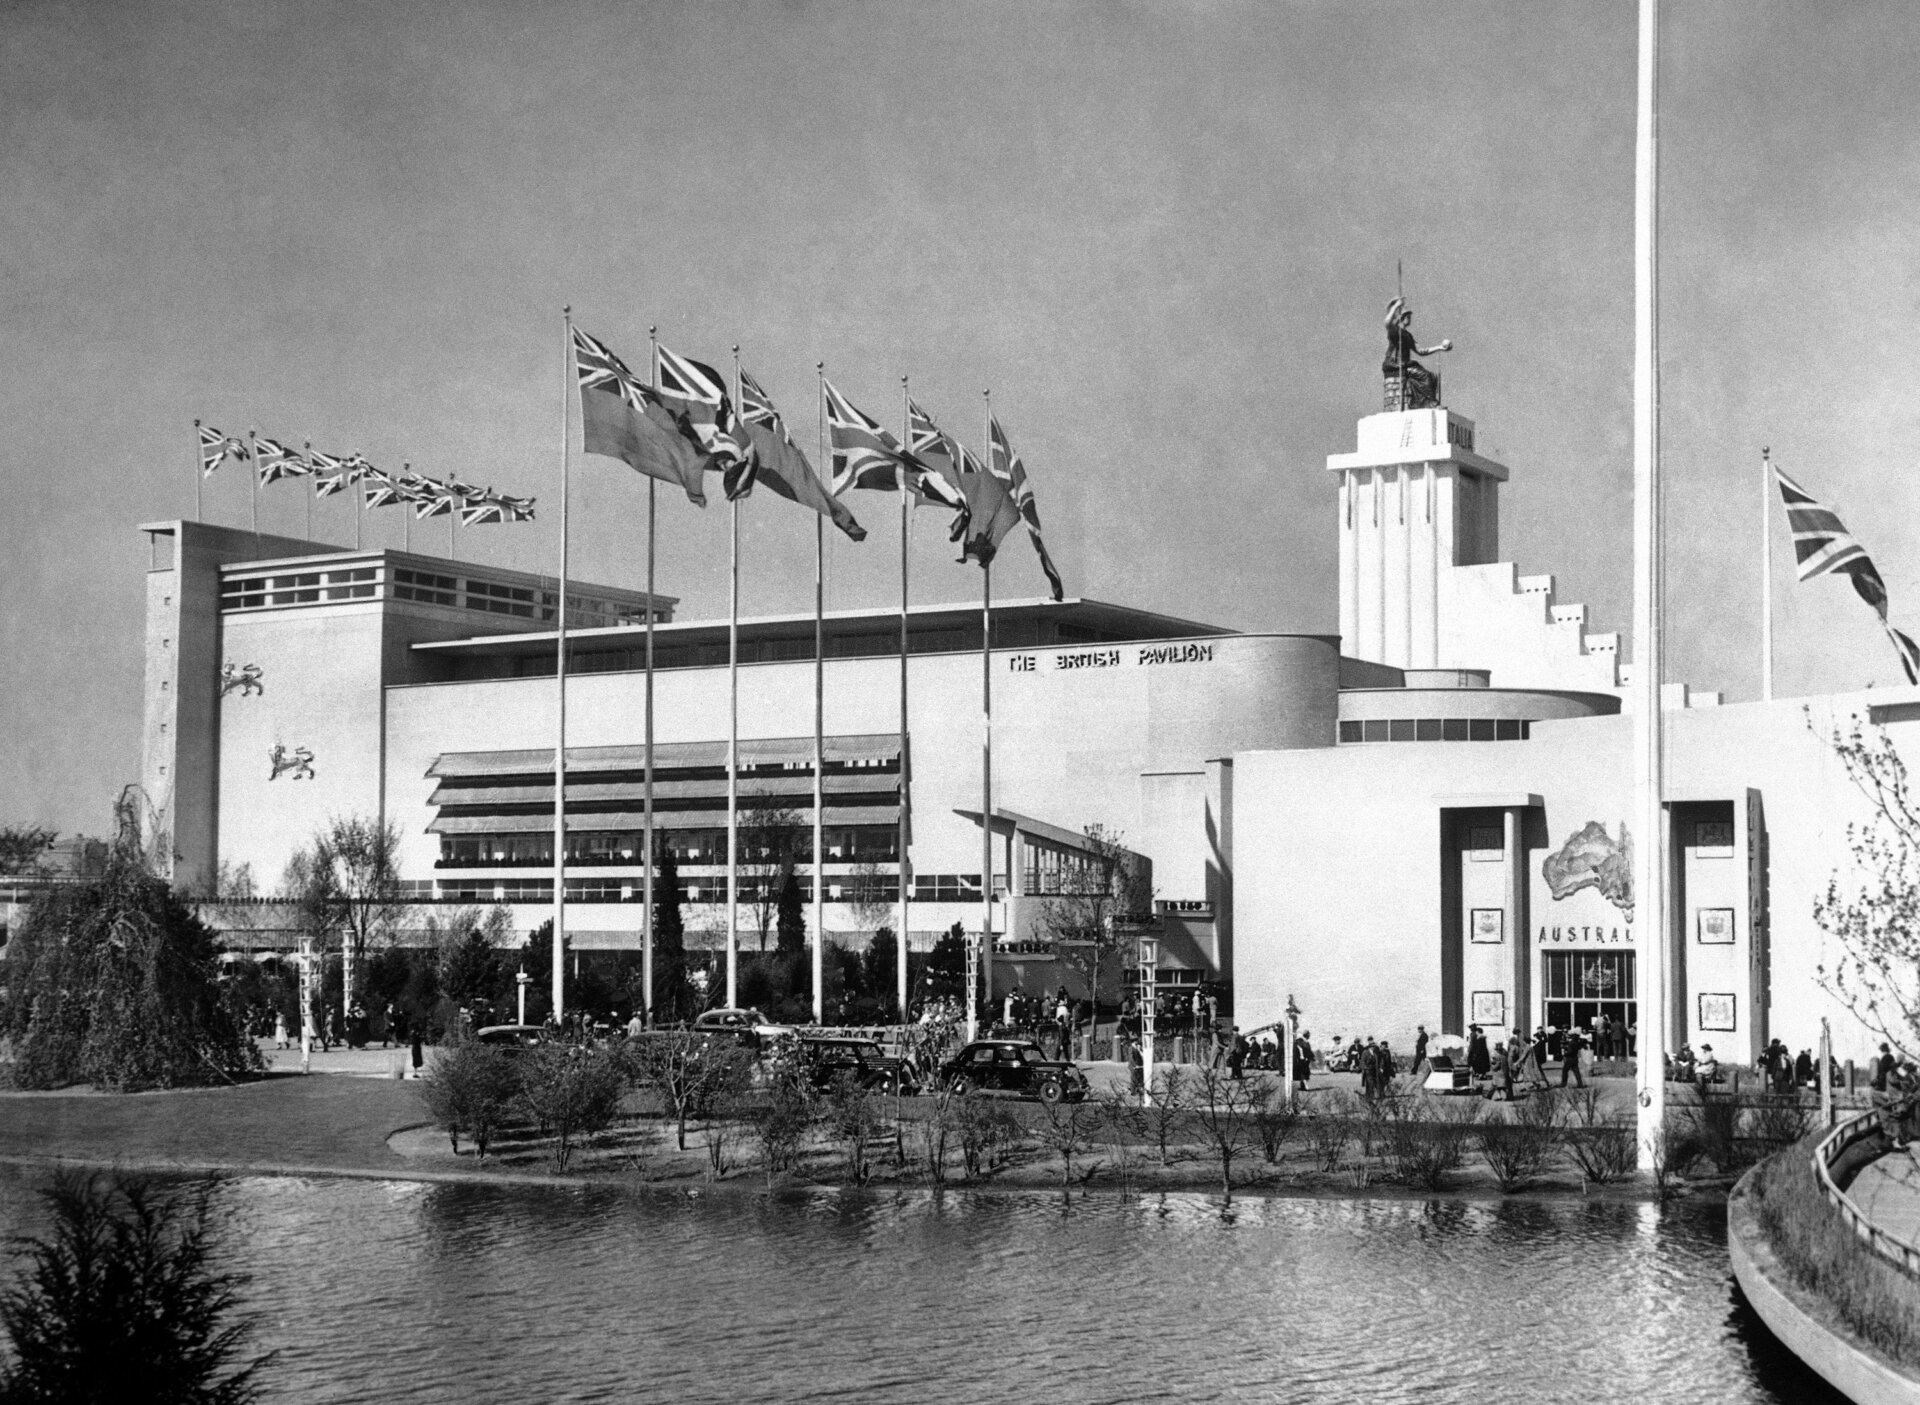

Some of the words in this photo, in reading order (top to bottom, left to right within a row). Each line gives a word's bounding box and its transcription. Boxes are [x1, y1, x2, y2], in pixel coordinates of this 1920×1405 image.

[1447, 421, 1474, 453] ITALIA
[1010, 655, 1036, 671] THE
[1056, 650, 1120, 670] BRITISH
[1138, 643, 1213, 665] PAVILION
